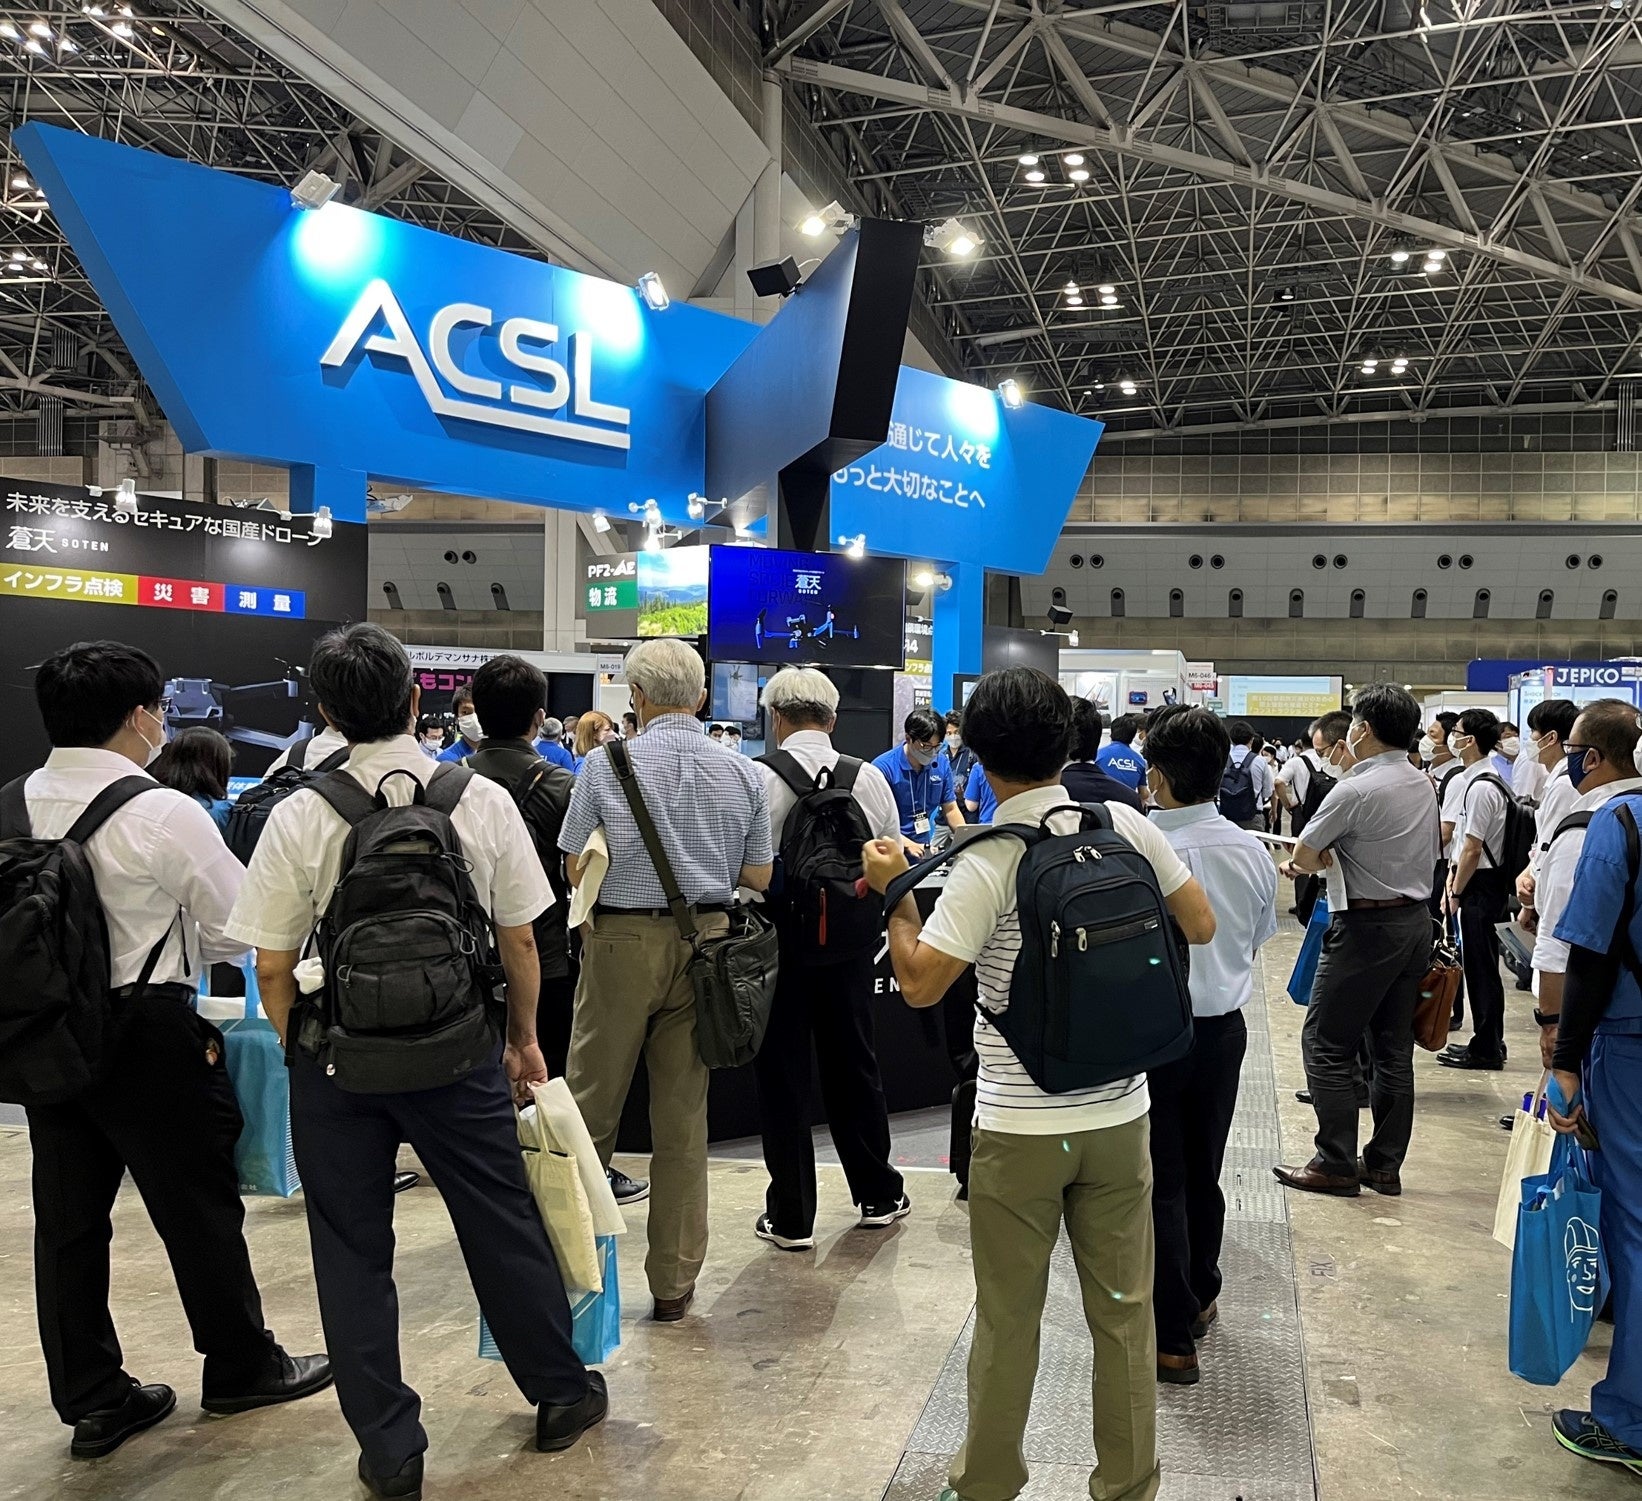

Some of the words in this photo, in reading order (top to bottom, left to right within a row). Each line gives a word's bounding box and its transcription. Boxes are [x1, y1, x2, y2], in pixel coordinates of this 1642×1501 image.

[320, 278, 630, 449] ACSL
[5, 525, 58, 554] 蒼天
[61, 538, 109, 552] SOTEN
[588, 559, 636, 578] PF2-AE
[4, 570, 124, 598] インフラ点検
[795, 574, 822, 590] 蒼天
[589, 586, 617, 607] 物流
[1556, 668, 1620, 684] JEPICO
[1107, 757, 1138, 772] ACSL
